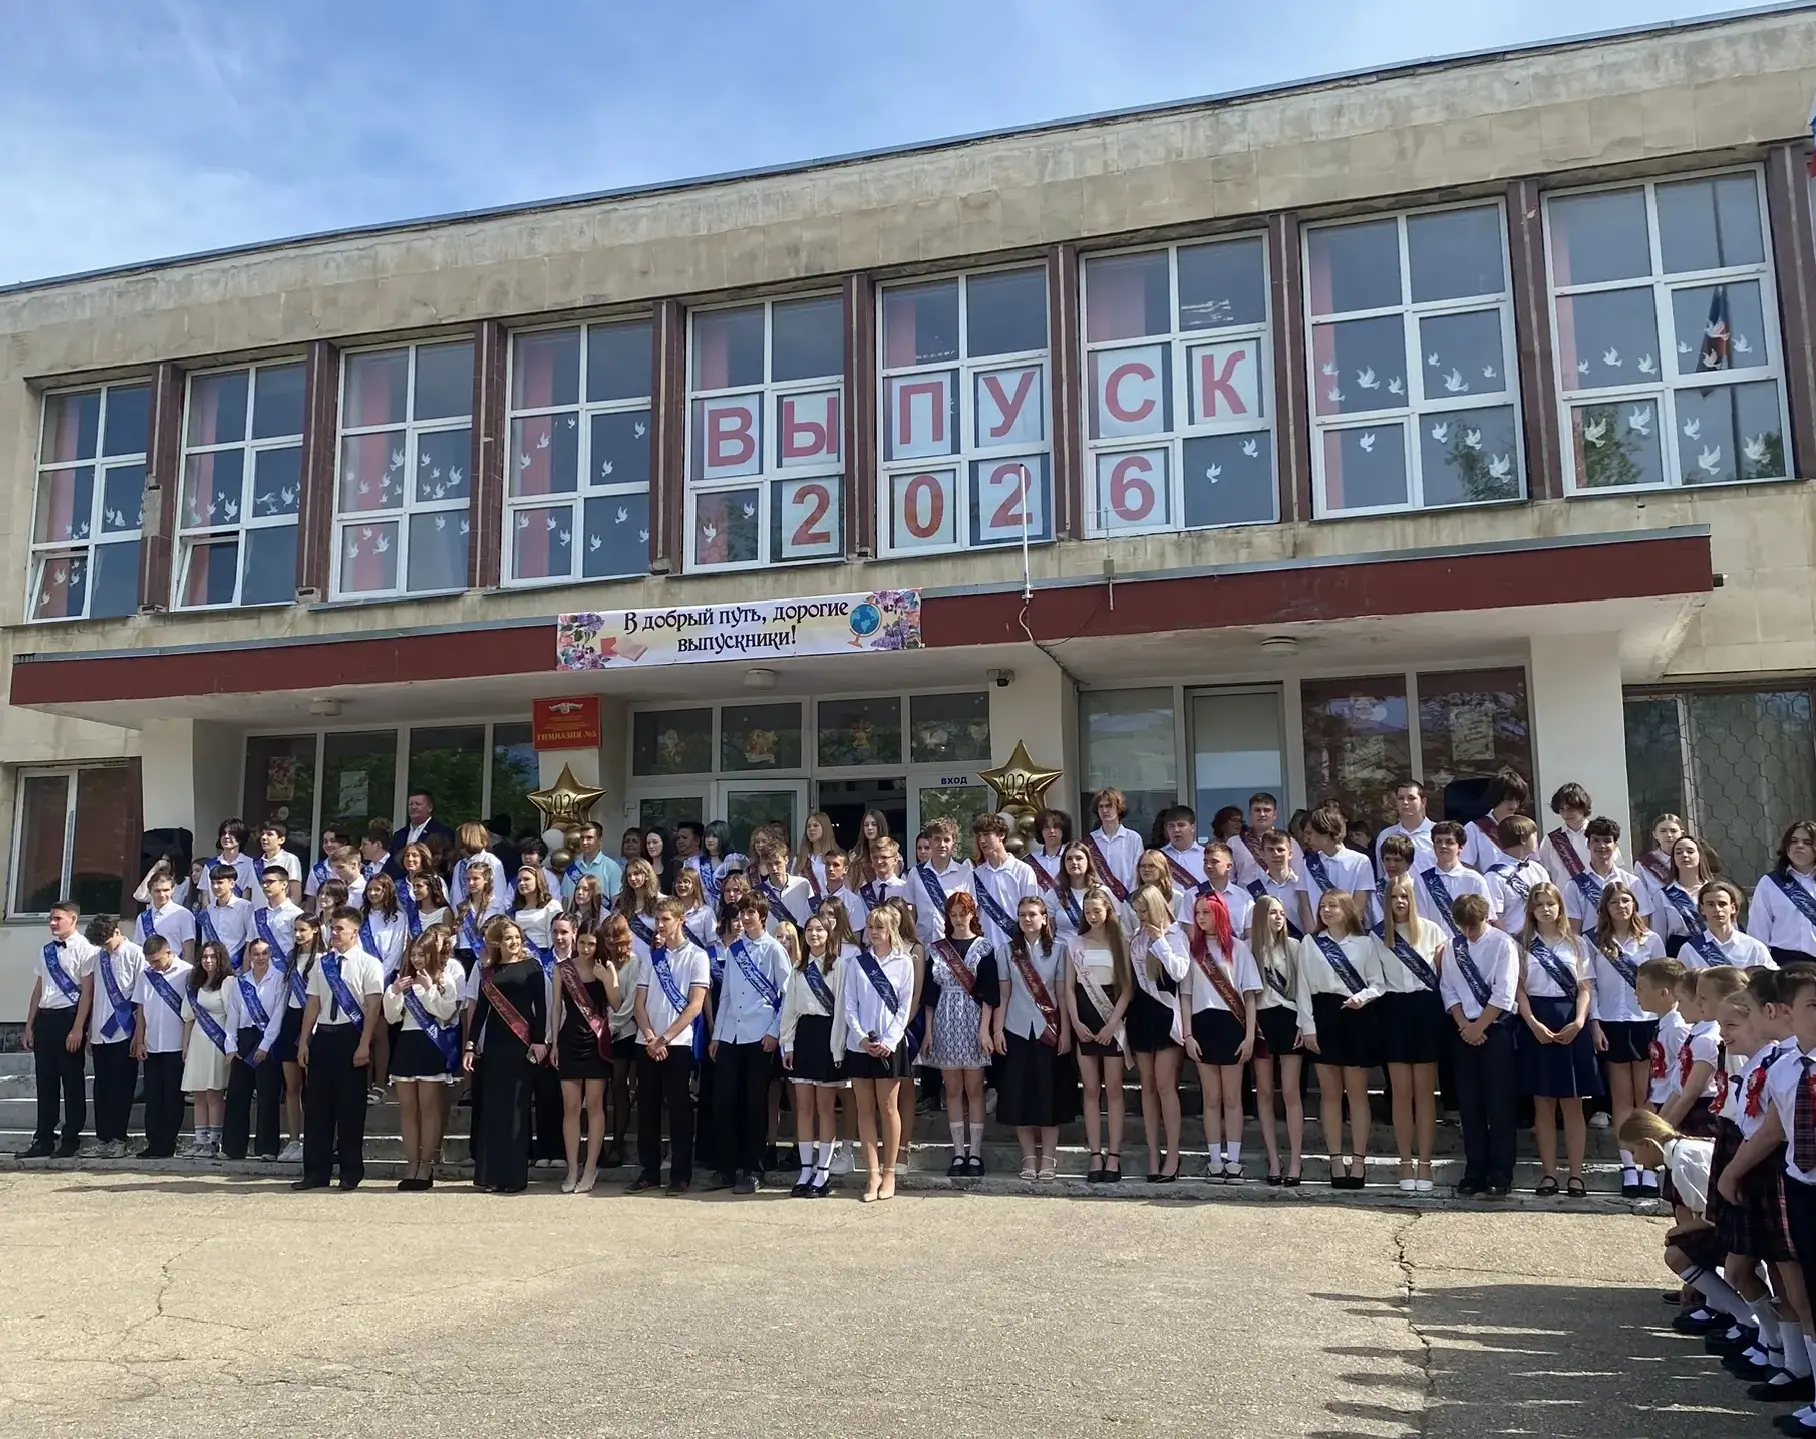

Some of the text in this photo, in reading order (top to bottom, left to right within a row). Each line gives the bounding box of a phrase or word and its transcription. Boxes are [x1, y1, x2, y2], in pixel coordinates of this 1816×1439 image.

[708, 350, 1248, 467] ВЫПУСК
[791, 456, 1155, 546] 2026
[623, 602, 849, 634] В добрый путь, дорогие
[677, 625, 796, 654] выпускники!
[940, 776, 967, 785] ВХОД
[998, 773, 1035, 796] 2026
[546, 793, 581, 815] 2026
